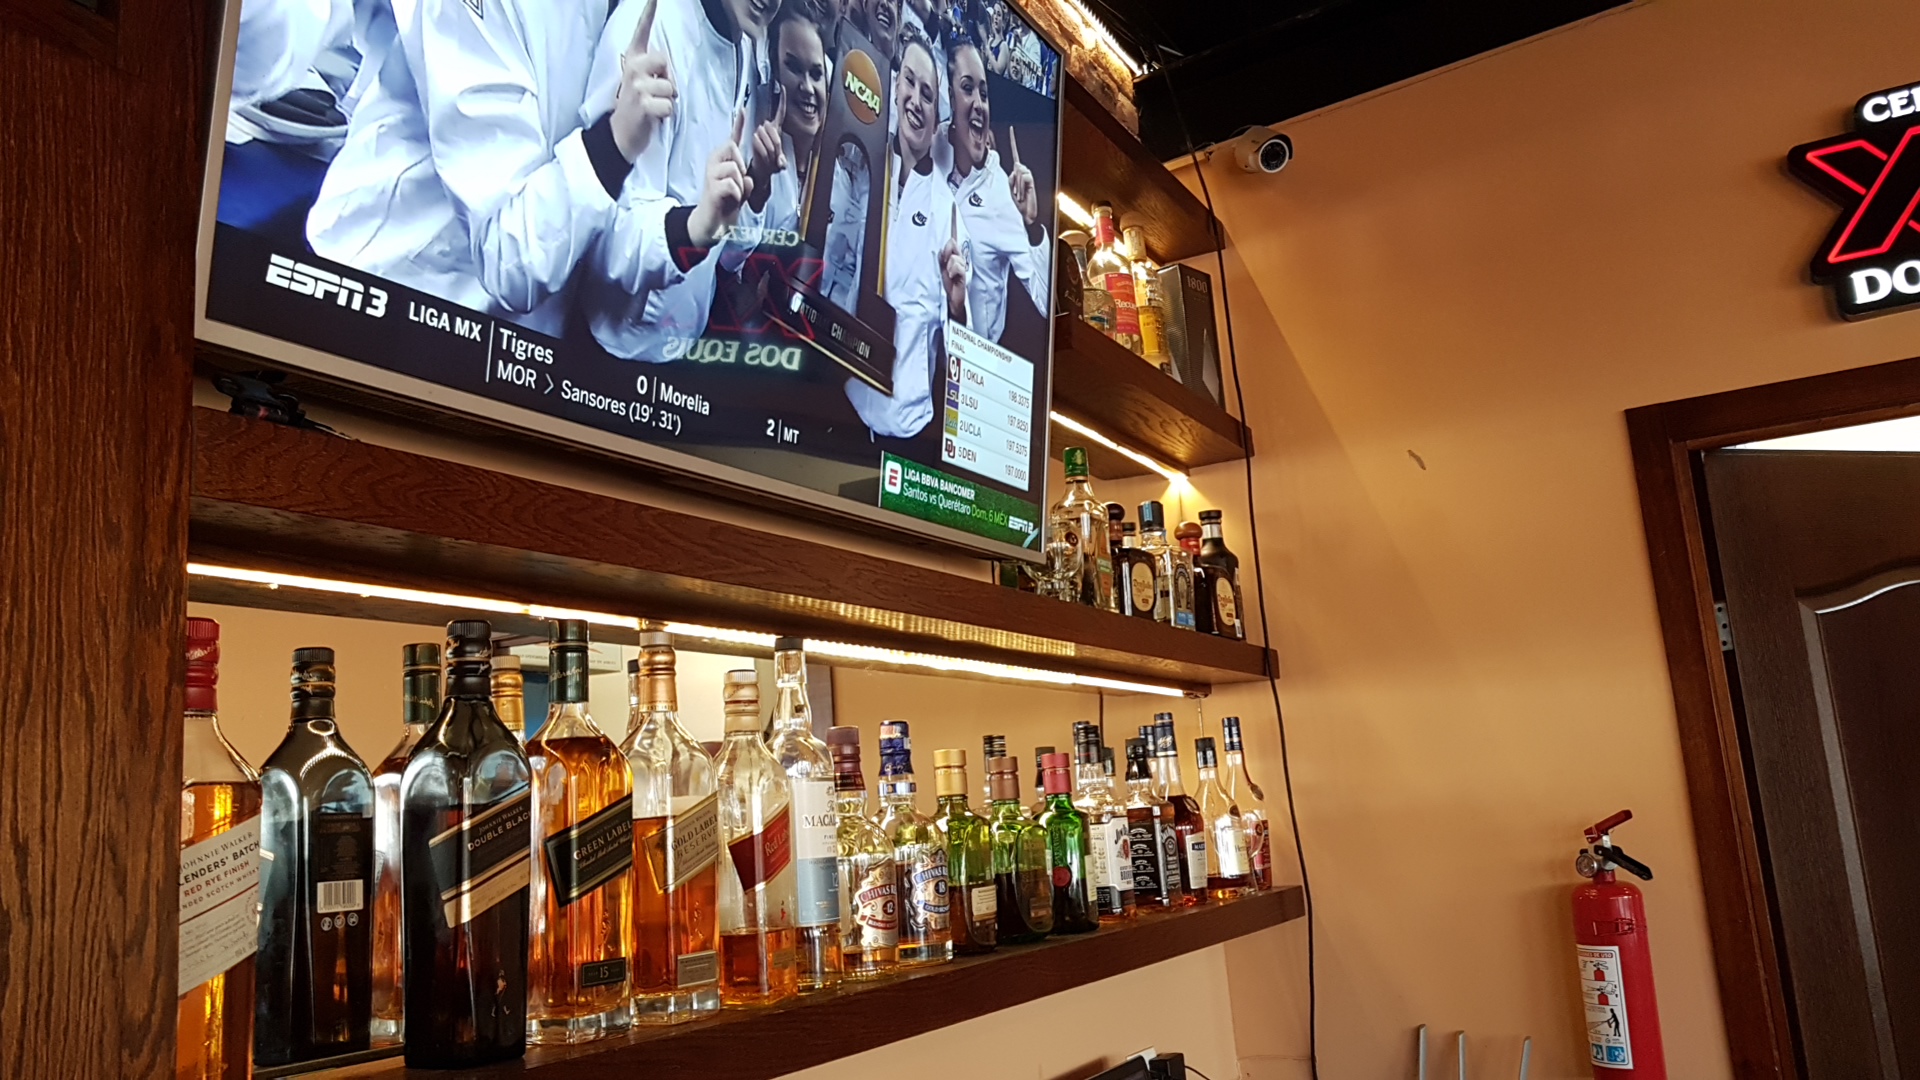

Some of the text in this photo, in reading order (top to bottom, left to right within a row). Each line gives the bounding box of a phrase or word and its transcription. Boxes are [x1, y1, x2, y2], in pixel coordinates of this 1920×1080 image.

[844, 71, 881, 115] NCAA
[1862, 87, 1920, 123] CE
[1186, 275, 1208, 293] 1800
[408, 301, 483, 342] LIGA MX
[499, 328, 554, 365] Tigres
[950, 339, 966, 354] FINAL
[951, 325, 1013, 364] NATIONAL CHAMPIONSHIP
[496, 359, 537, 390] MOR
[561, 380, 627, 416] Sansores
[636, 375, 648, 396] 0
[966, 368, 985, 388] OKLA
[659, 382, 710, 416] Morelia
[960, 393, 979, 411] 3 LSU
[766, 418, 775, 437] 2
[783, 428, 799, 444] MT
[959, 420, 964, 431] 2
[964, 421, 982, 439] UCLA
[958, 446, 977, 463] 5 DEN
[904, 466, 976, 501] LIGA BBVA BANCOMER
[902, 482, 928, 503] Santos
[928, 493, 937, 504] vs
[937, 493, 971, 516] Querétaro
[971, 505, 988, 521] Dom.
[988, 508, 994, 523] 6
[221, 831, 254, 852] WALKER
[467, 824, 504, 852] DOUBLE
[573, 836, 605, 861] GREEN
[606, 820, 633, 842] LABEL
[671, 831, 694, 851] GOLD
[676, 827, 718, 858] RESERVE
[232, 839, 260, 861] BATCH
[183, 860, 250, 898] RED RYE FINISH
[937, 881, 946, 893] 18
[180, 895, 204, 911] NDED
[206, 880, 235, 898] SCOTCH
[860, 885, 890, 902] CHIVAS
[886, 902, 894, 913] 12
[599, 965, 609, 978] 15
